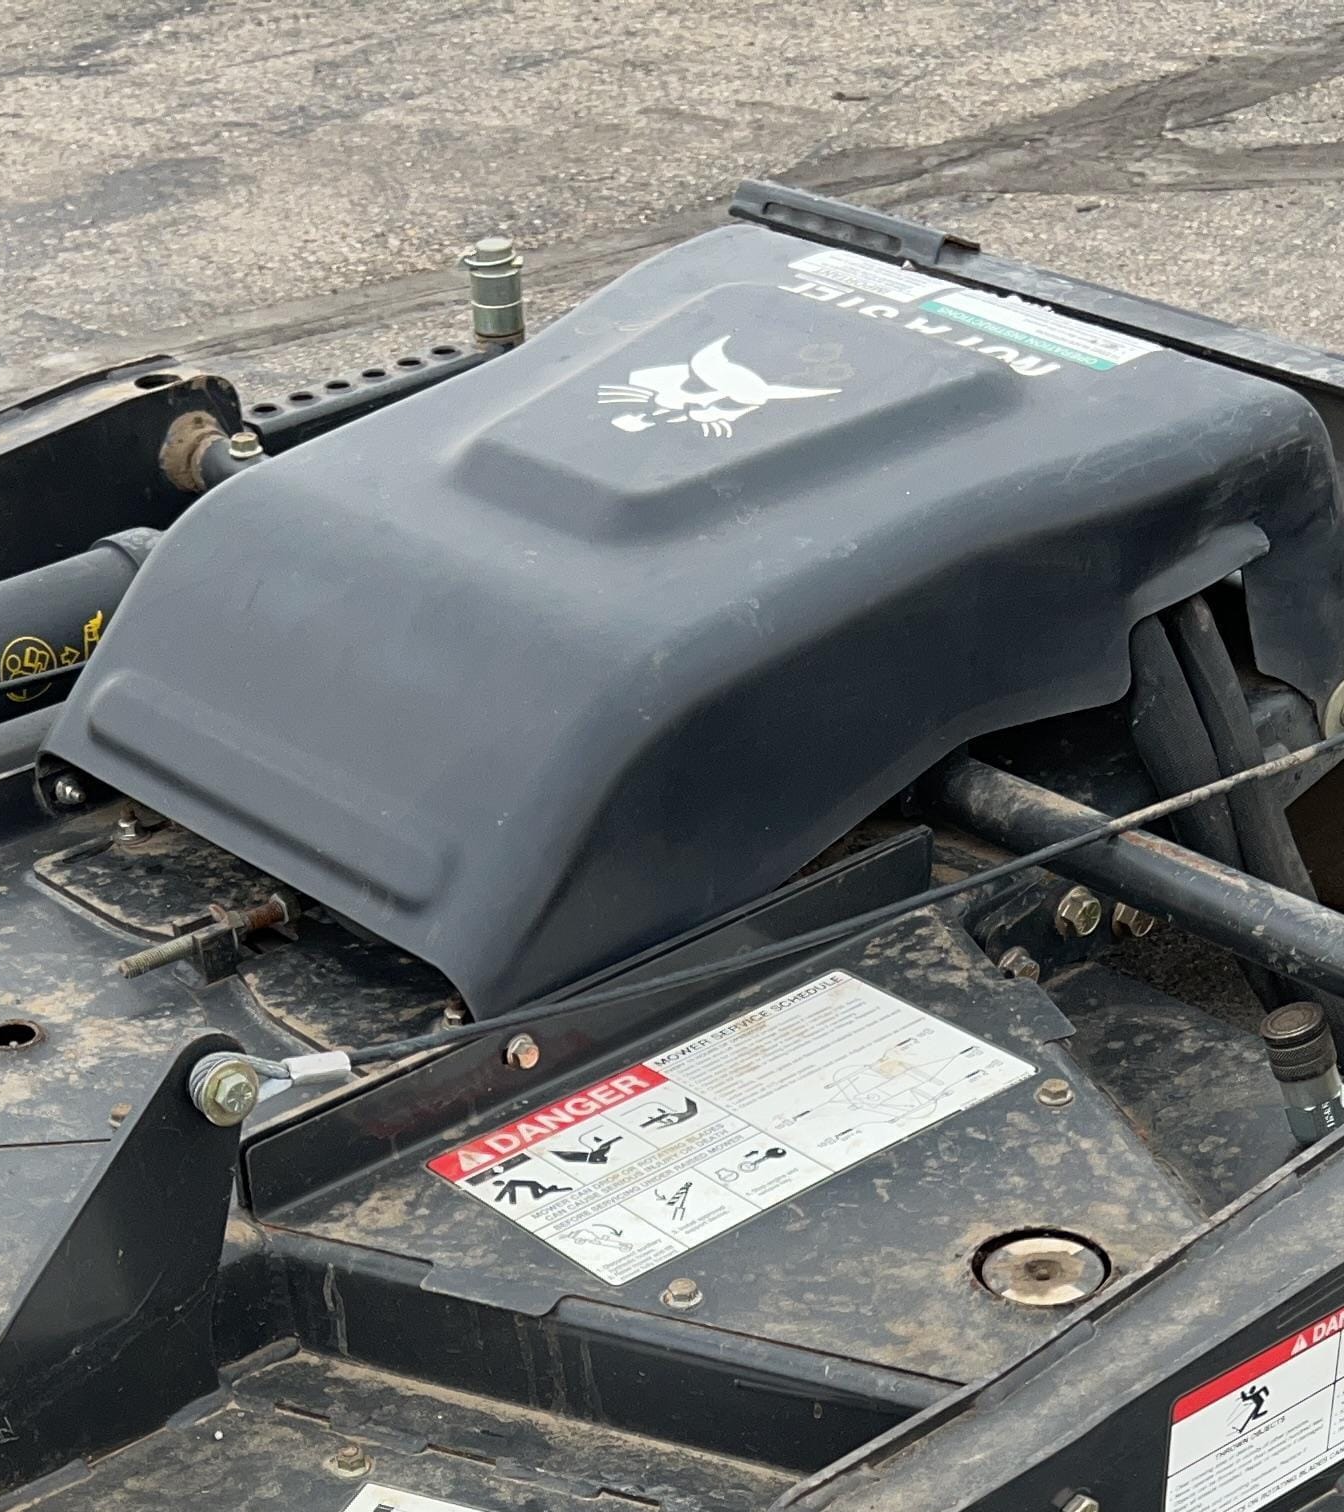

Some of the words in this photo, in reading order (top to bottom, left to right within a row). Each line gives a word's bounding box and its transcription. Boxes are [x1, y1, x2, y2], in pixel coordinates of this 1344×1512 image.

[937, 306, 1030, 344] INSTRUCTIONS
[1030, 341, 1098, 366] OPERATION
[652, 1038, 712, 1067] MOWER
[708, 1009, 773, 1040] SERVICE
[768, 975, 844, 1012] SCHEDULE
[483, 1072, 652, 1155] DANGER
[706, 1134, 746, 1154] MOWER
[529, 1197, 572, 1219] MOWER
[568, 1186, 594, 1200] CAN
[619, 1165, 639, 1175] OR
[635, 1141, 688, 1167] ROTATING
[684, 1122, 726, 1143] BLADES
[542, 1207, 569, 1221] CAN
[565, 1191, 603, 1210] CAUSE
[598, 1170, 646, 1194] SERIOUS
[642, 1152, 681, 1172] INJURY
[678, 1144, 697, 1155] OR
[693, 1128, 731, 1147] DEATH
[1215, 1434, 1248, 1461] THROWN
[1250, 1413, 1285, 1441] OBJECTS
[1247, 1495, 1258, 1508] OR
[1260, 1473, 1297, 1501] ROTATING
[1298, 1455, 1327, 1478] BLADES
[1329, 1444, 1344, 1460] CAN
